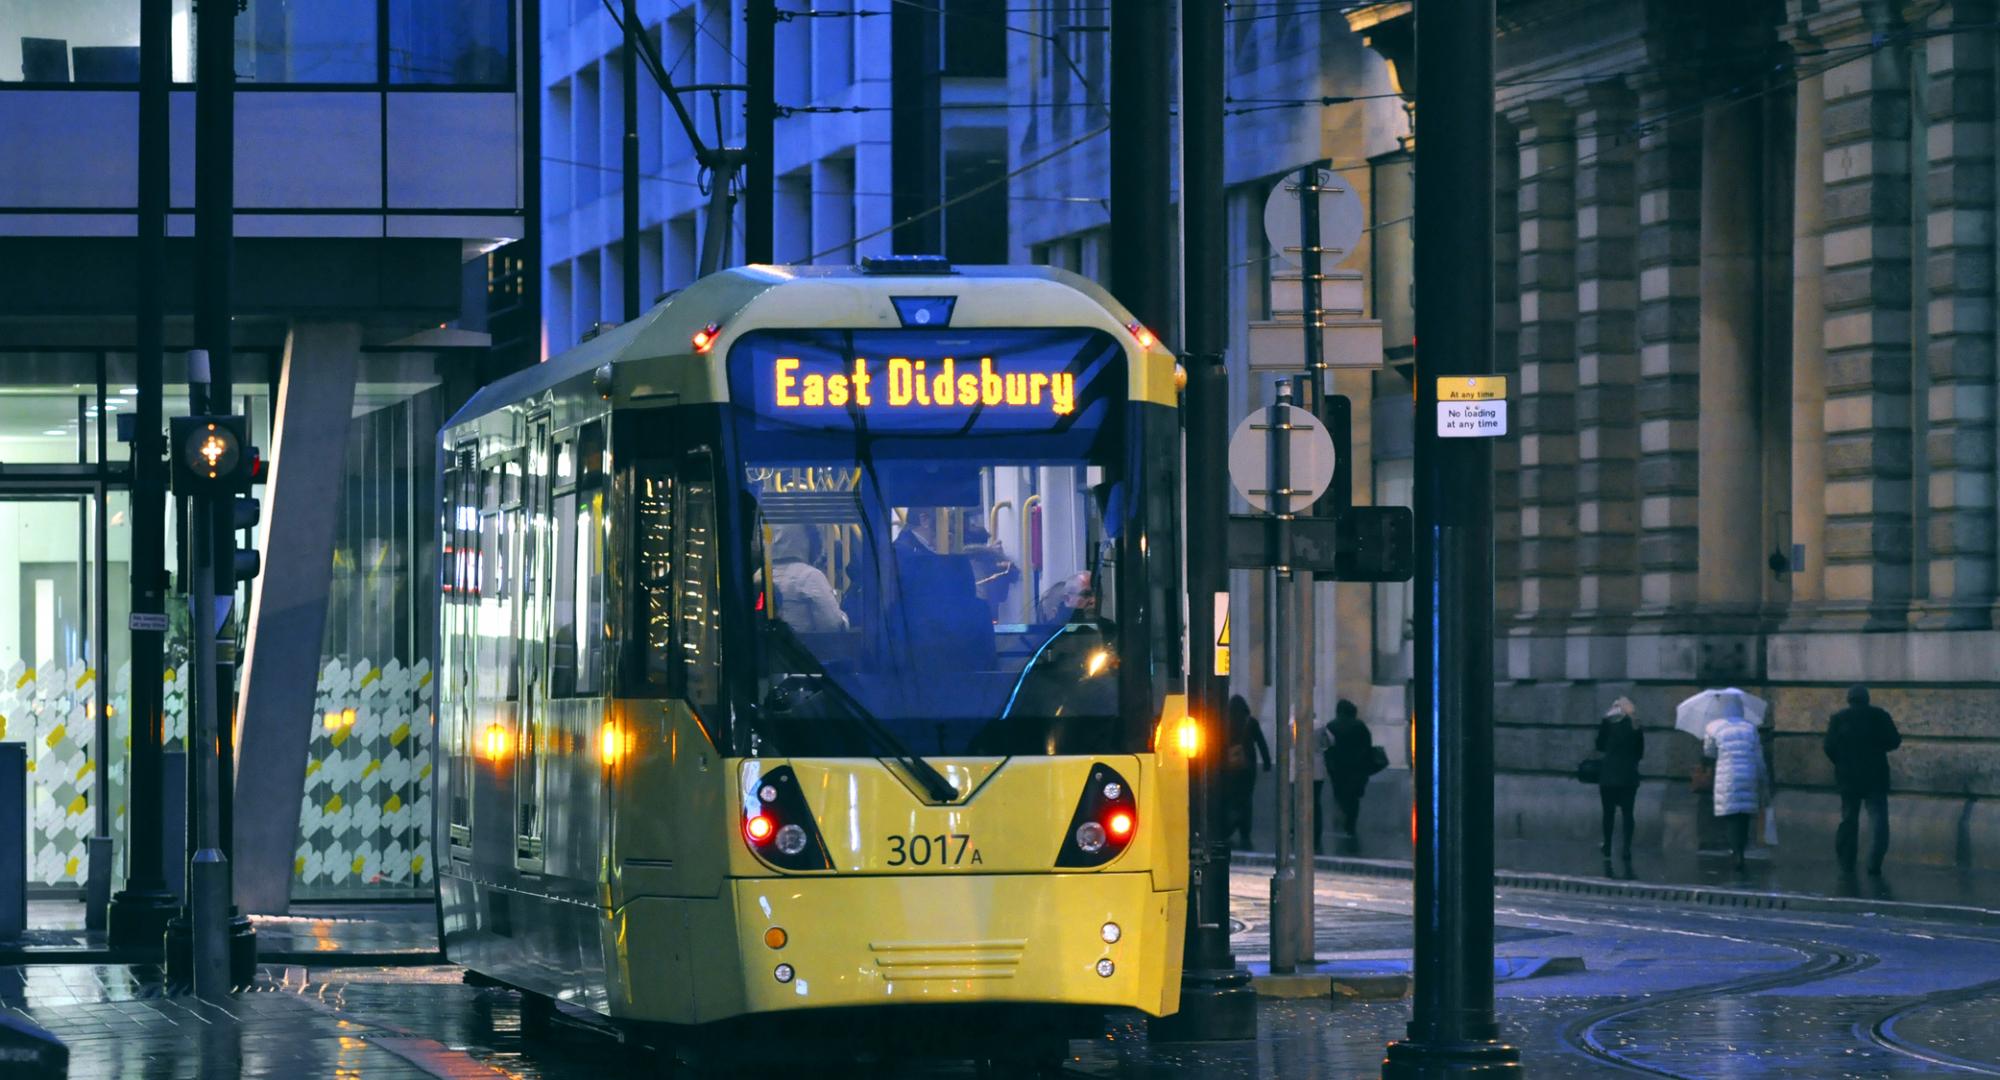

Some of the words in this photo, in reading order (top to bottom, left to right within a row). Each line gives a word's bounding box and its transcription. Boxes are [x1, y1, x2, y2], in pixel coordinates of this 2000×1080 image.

[776, 358, 871, 407] East
[888, 357, 1075, 416] Didsbury
[1448, 409, 1461, 418] No
[1464, 409, 1496, 418] loading
[1478, 420, 1498, 428] time
